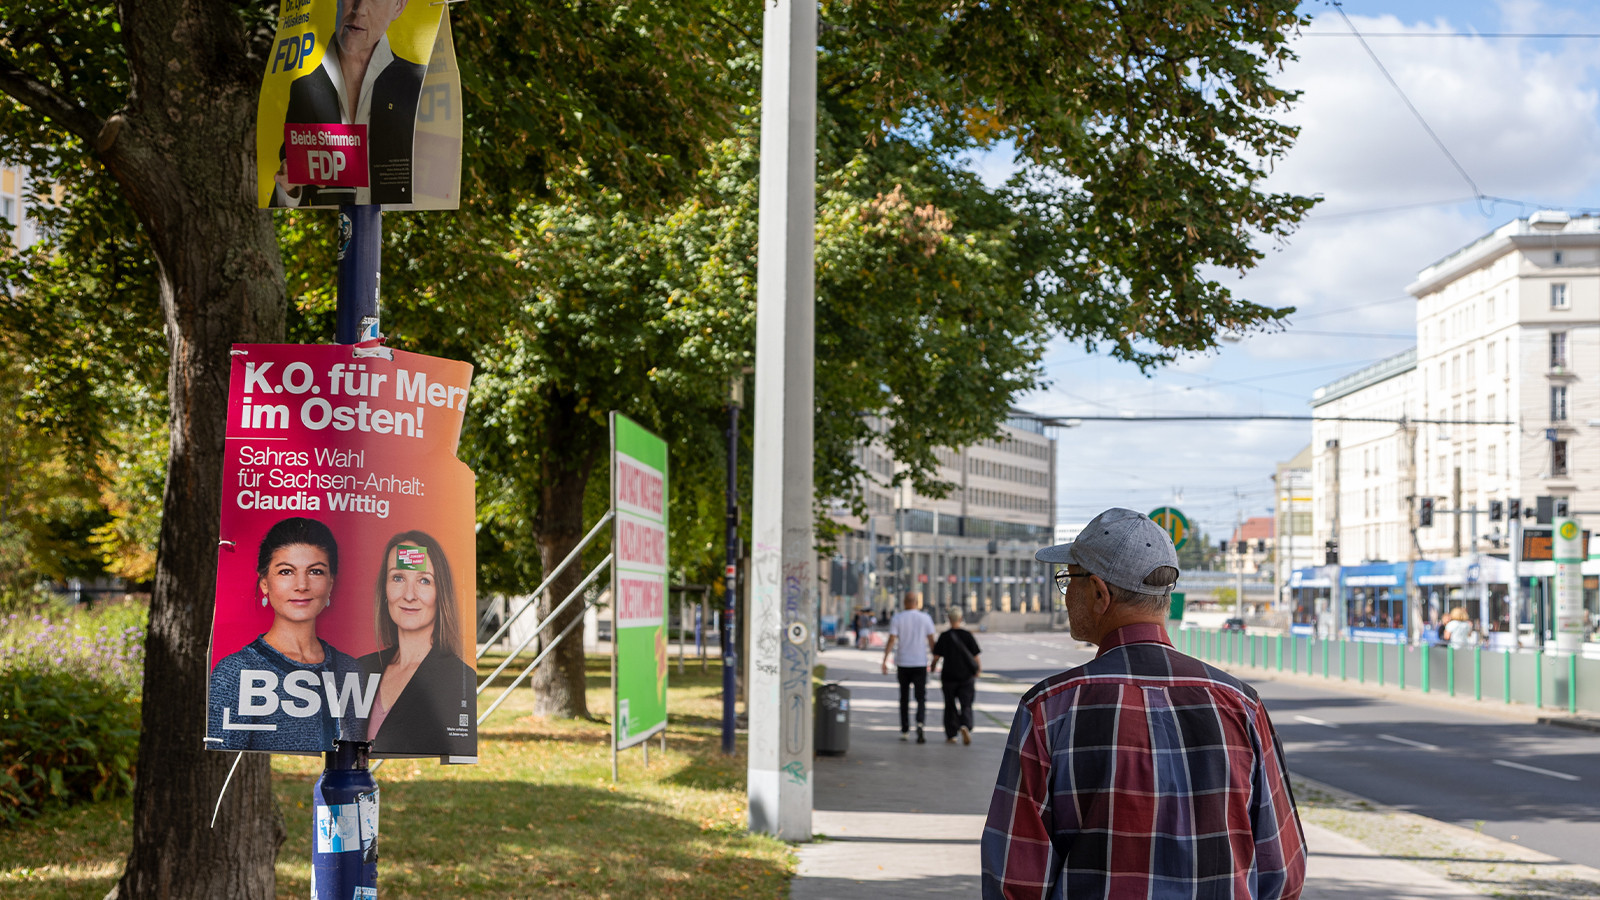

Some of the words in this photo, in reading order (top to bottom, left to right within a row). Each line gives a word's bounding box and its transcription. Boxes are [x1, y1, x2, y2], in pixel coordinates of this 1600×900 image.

[271, 32, 315, 74] FDP
[290, 130, 317, 145] Beide
[318, 131, 360, 146] Stimmen
[307, 150, 346, 181] FDP
[243, 361, 321, 395] K.O.
[328, 363, 387, 397] für
[396, 368, 468, 412] Merz
[241, 397, 290, 429] im
[301, 397, 424, 439] Osten!
[238, 445, 309, 467] Sahras
[314, 447, 364, 468] Wahl
[237, 468, 264, 488] für
[268, 468, 425, 496] Sachsen-Anhalt:
[236, 490, 321, 511] Claudia
[326, 492, 390, 519] Wittig
[238, 669, 381, 718] BSW
